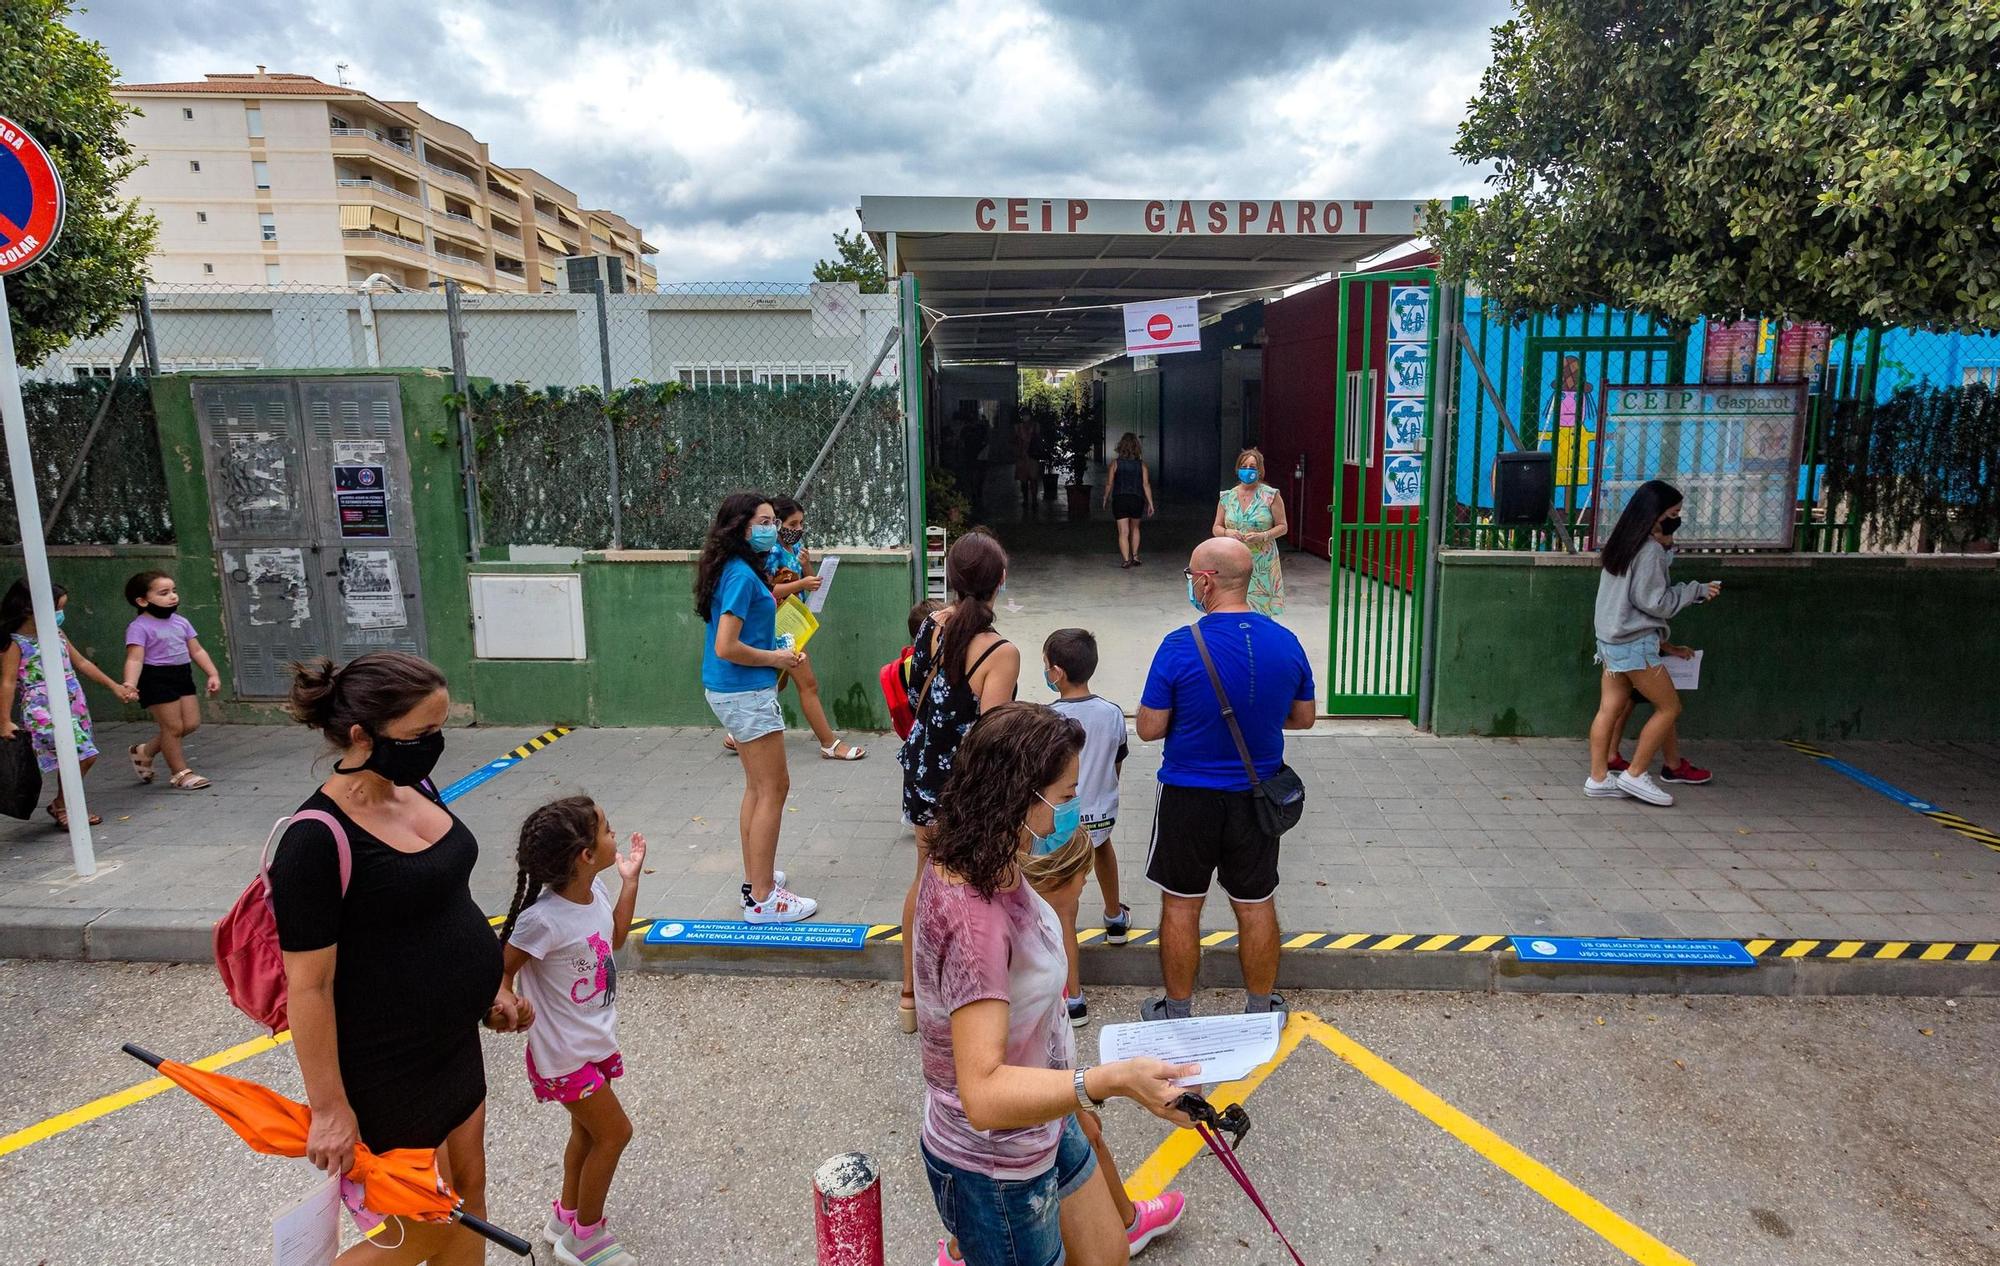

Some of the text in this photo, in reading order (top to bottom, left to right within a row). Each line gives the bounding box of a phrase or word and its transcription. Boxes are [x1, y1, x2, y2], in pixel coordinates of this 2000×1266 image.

[1144, 200, 1374, 233] GASPAROT
[1717, 395, 1790, 413] Gasparot
[1600, 951, 1662, 959] OBLIGATORIO
